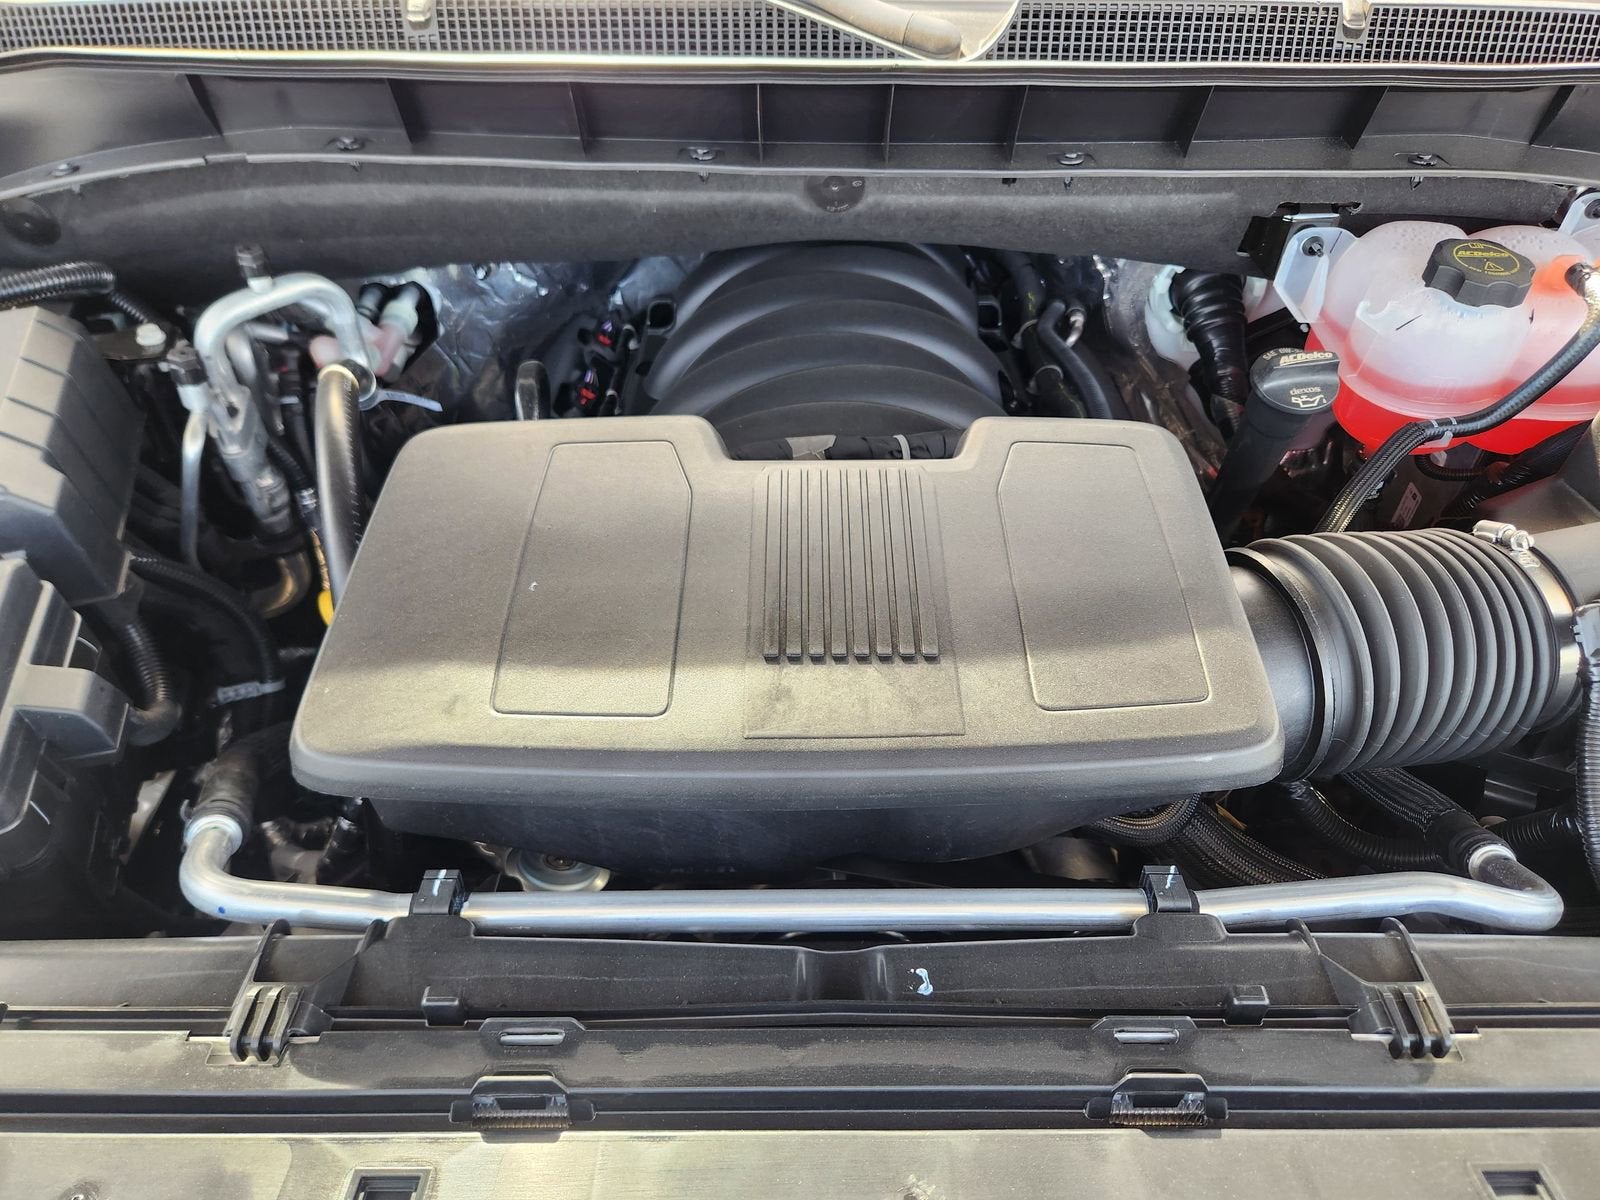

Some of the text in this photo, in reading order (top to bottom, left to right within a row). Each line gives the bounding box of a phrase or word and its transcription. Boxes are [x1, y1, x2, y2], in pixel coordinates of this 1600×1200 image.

[1262, 350, 1278, 360] SAE
[1280, 351, 1333, 365] ACDelco
[1290, 387, 1321, 395] dexos
